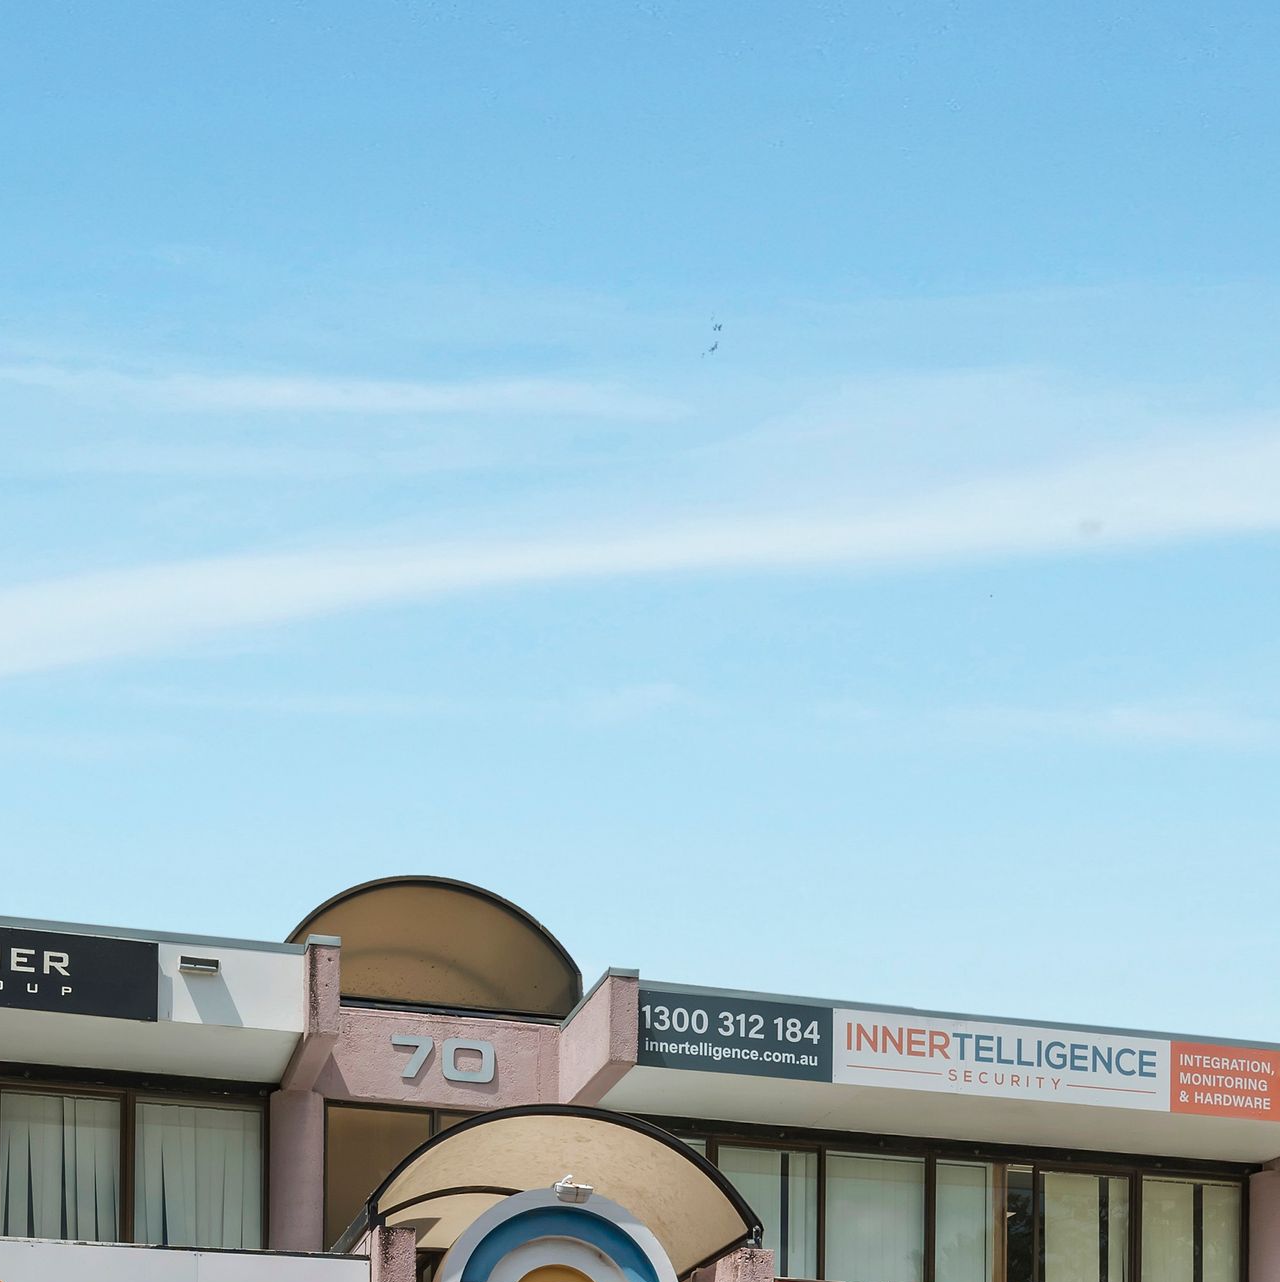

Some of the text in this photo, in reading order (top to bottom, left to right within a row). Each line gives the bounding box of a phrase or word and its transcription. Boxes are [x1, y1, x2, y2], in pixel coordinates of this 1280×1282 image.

[641, 1004, 820, 1045] 1300 312 184
[391, 1034, 496, 1085] 70
[645, 1037, 819, 1067] innertelligence.com.au
[846, 1021, 1157, 1078] INNERTELLIGENCE
[1179, 1054, 1275, 1076] INTEGRATION,
[948, 1068, 1063, 1090] SECURITY
[1179, 1072, 1268, 1092] MONITORING
[1179, 1090, 1271, 1110] & HARDWARE
